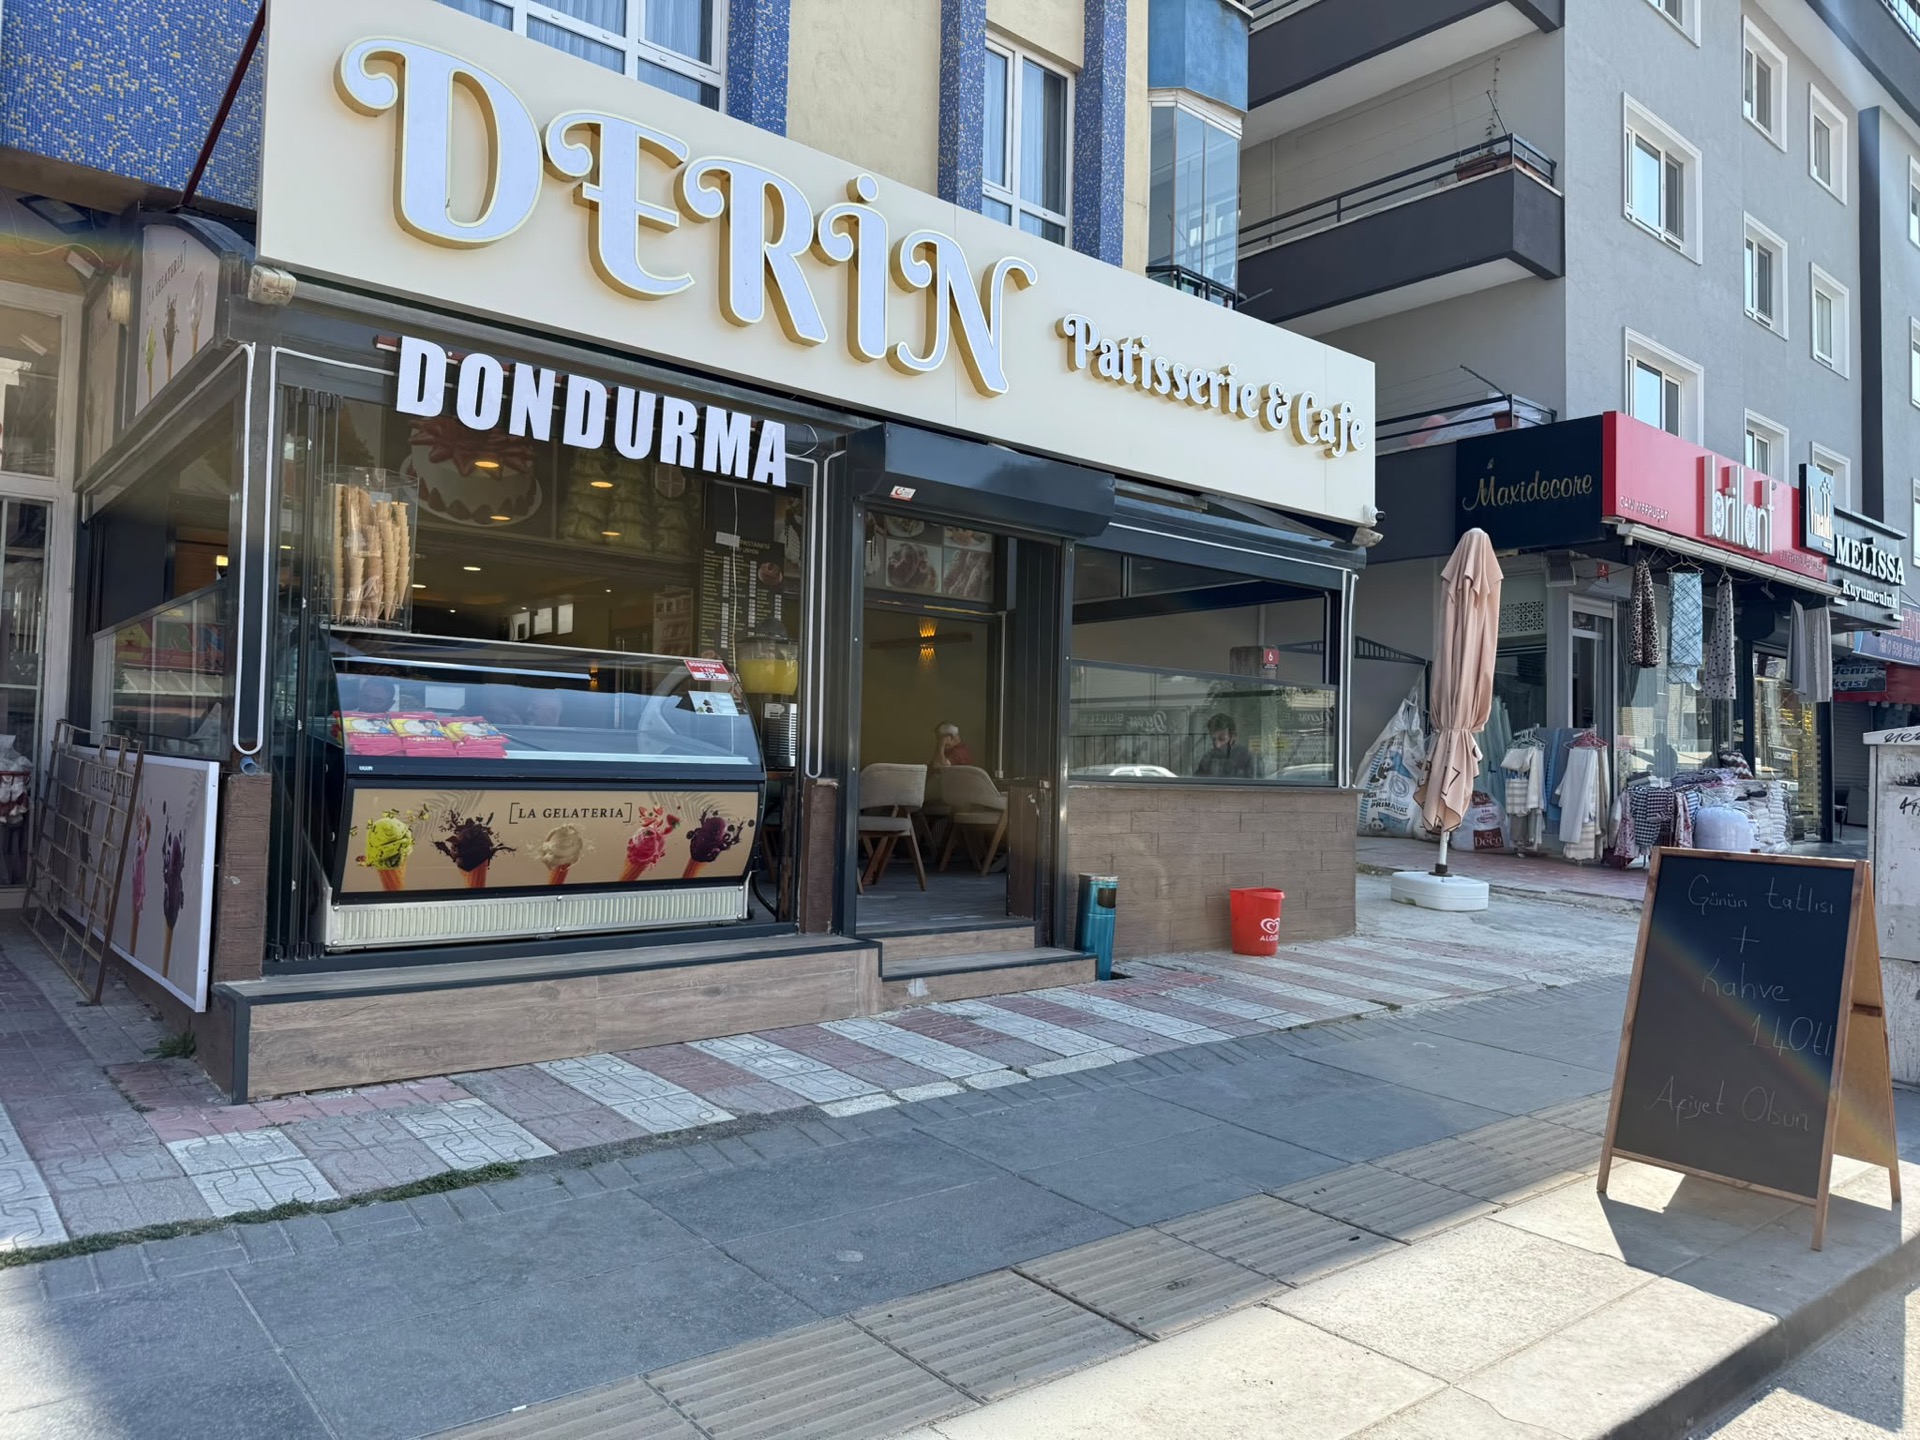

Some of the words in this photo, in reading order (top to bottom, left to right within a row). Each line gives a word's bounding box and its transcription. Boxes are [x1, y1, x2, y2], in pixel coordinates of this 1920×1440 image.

[334, 35, 1038, 397] DERİN
[396, 335, 787, 488] DONDURMA
[1055, 313, 1259, 419] Patisserie
[1259, 381, 1291, 431] &
[1290, 391, 1366, 458] Cafe
[1462, 470, 1592, 511] Maxidecore
[1704, 455, 1775, 554] brilant
[1835, 533, 1906, 586] MELİSSA
[1842, 578, 1898, 609] Kuyumculuk
[518, 808, 536, 819] LA
[542, 808, 624, 819] GELATERIA
[1688, 874, 1748, 915] Günün
